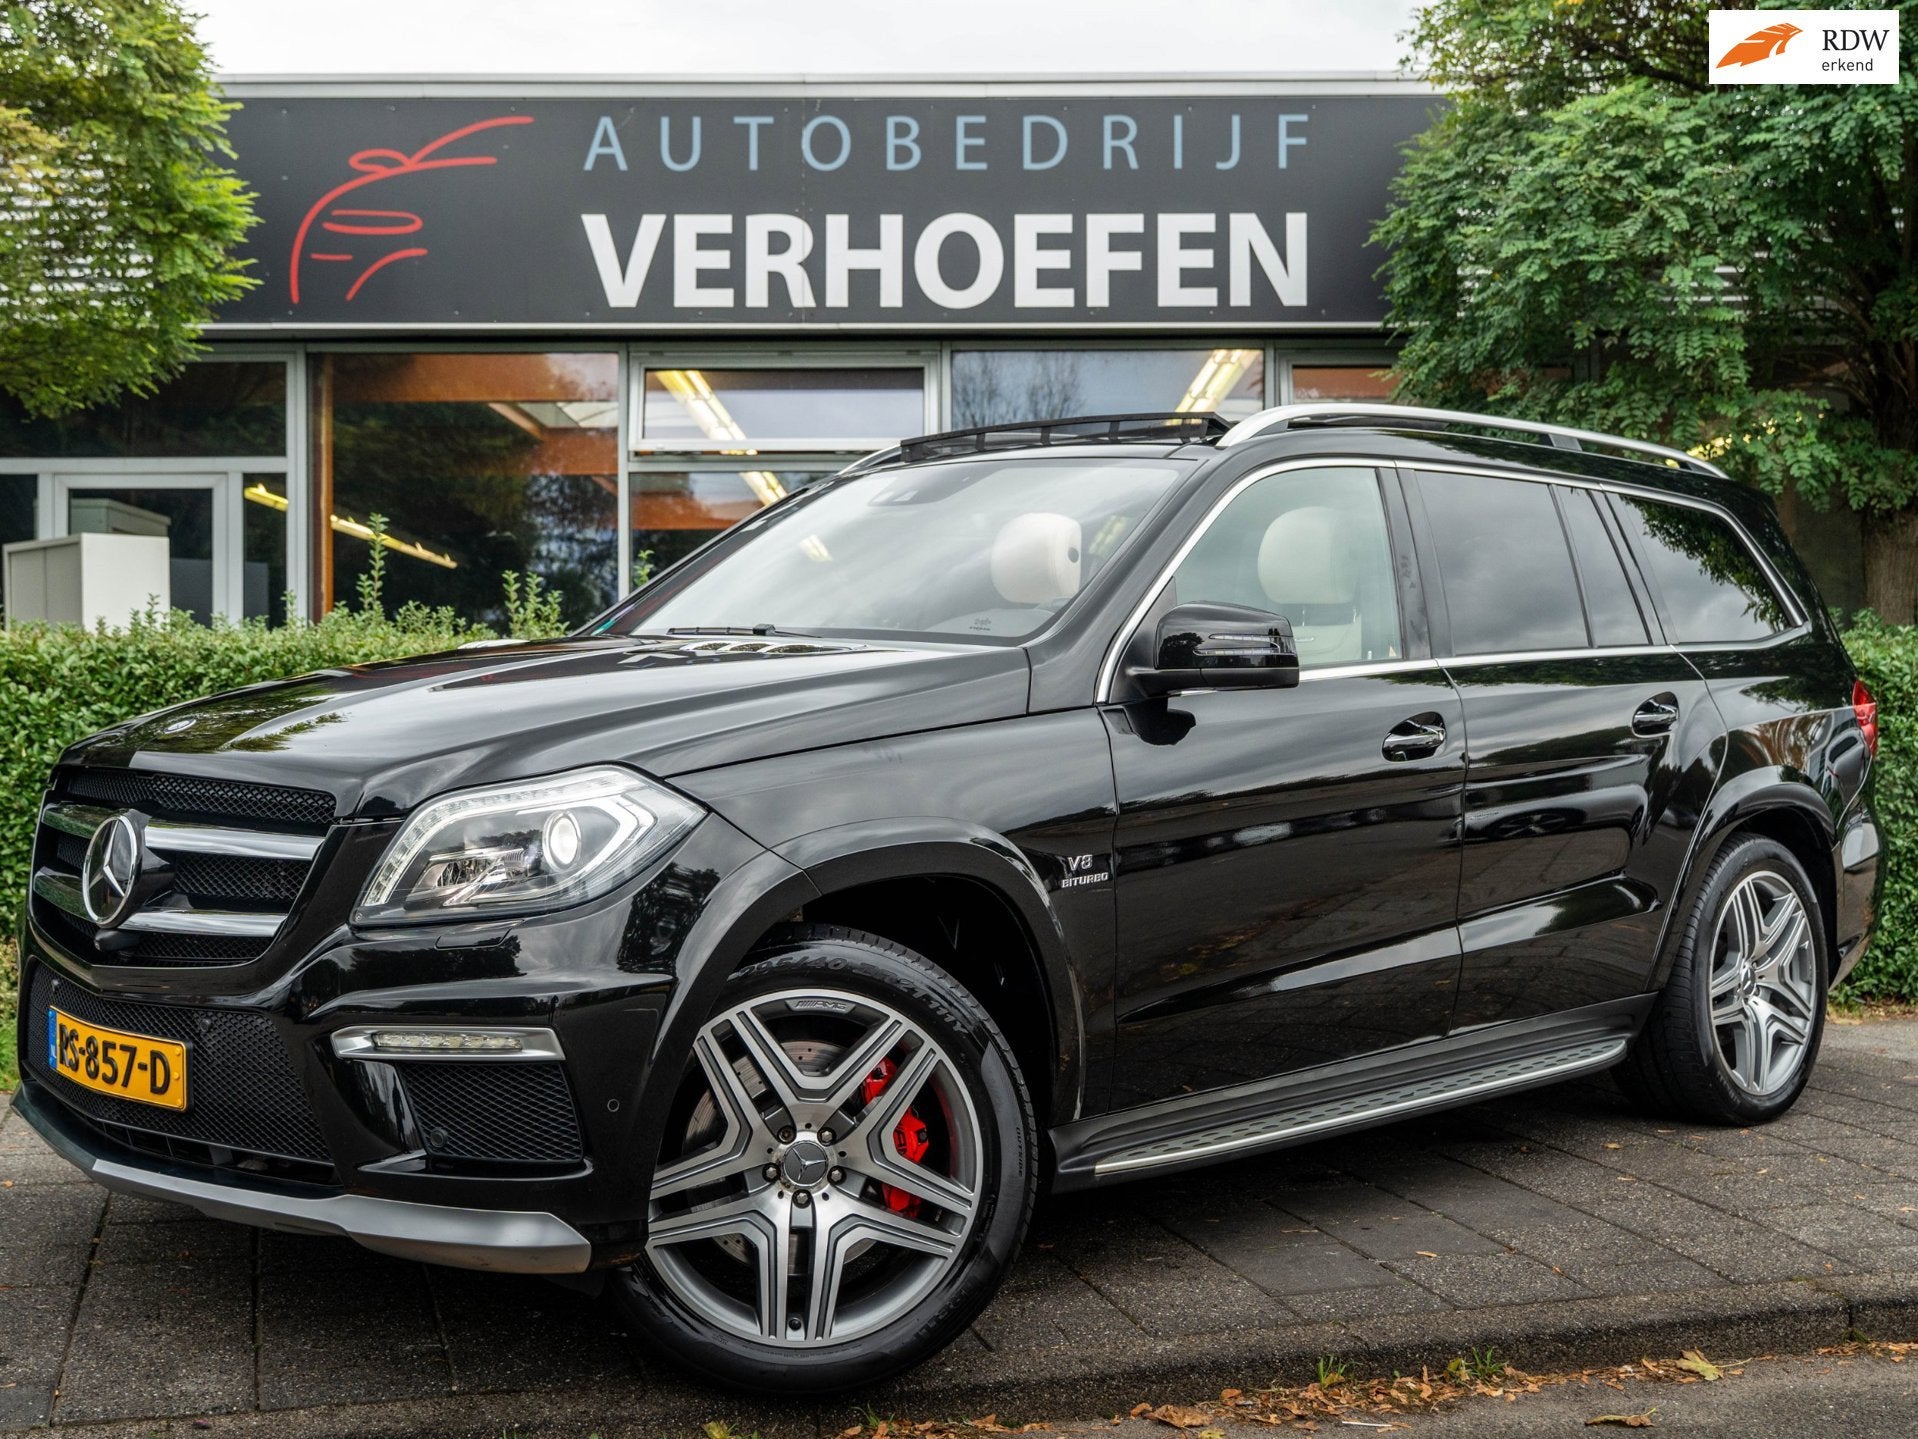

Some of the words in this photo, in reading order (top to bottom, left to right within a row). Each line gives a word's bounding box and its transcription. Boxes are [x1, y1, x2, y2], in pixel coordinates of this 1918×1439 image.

[583, 114, 1309, 172] AUTOBEDRIJF
[581, 212, 1307, 309] VERHOEFEN
[1061, 872, 1109, 889] BITURBO
[1067, 854, 1093, 871] V8
[58, 1023, 171, 1096] RS-857-D
